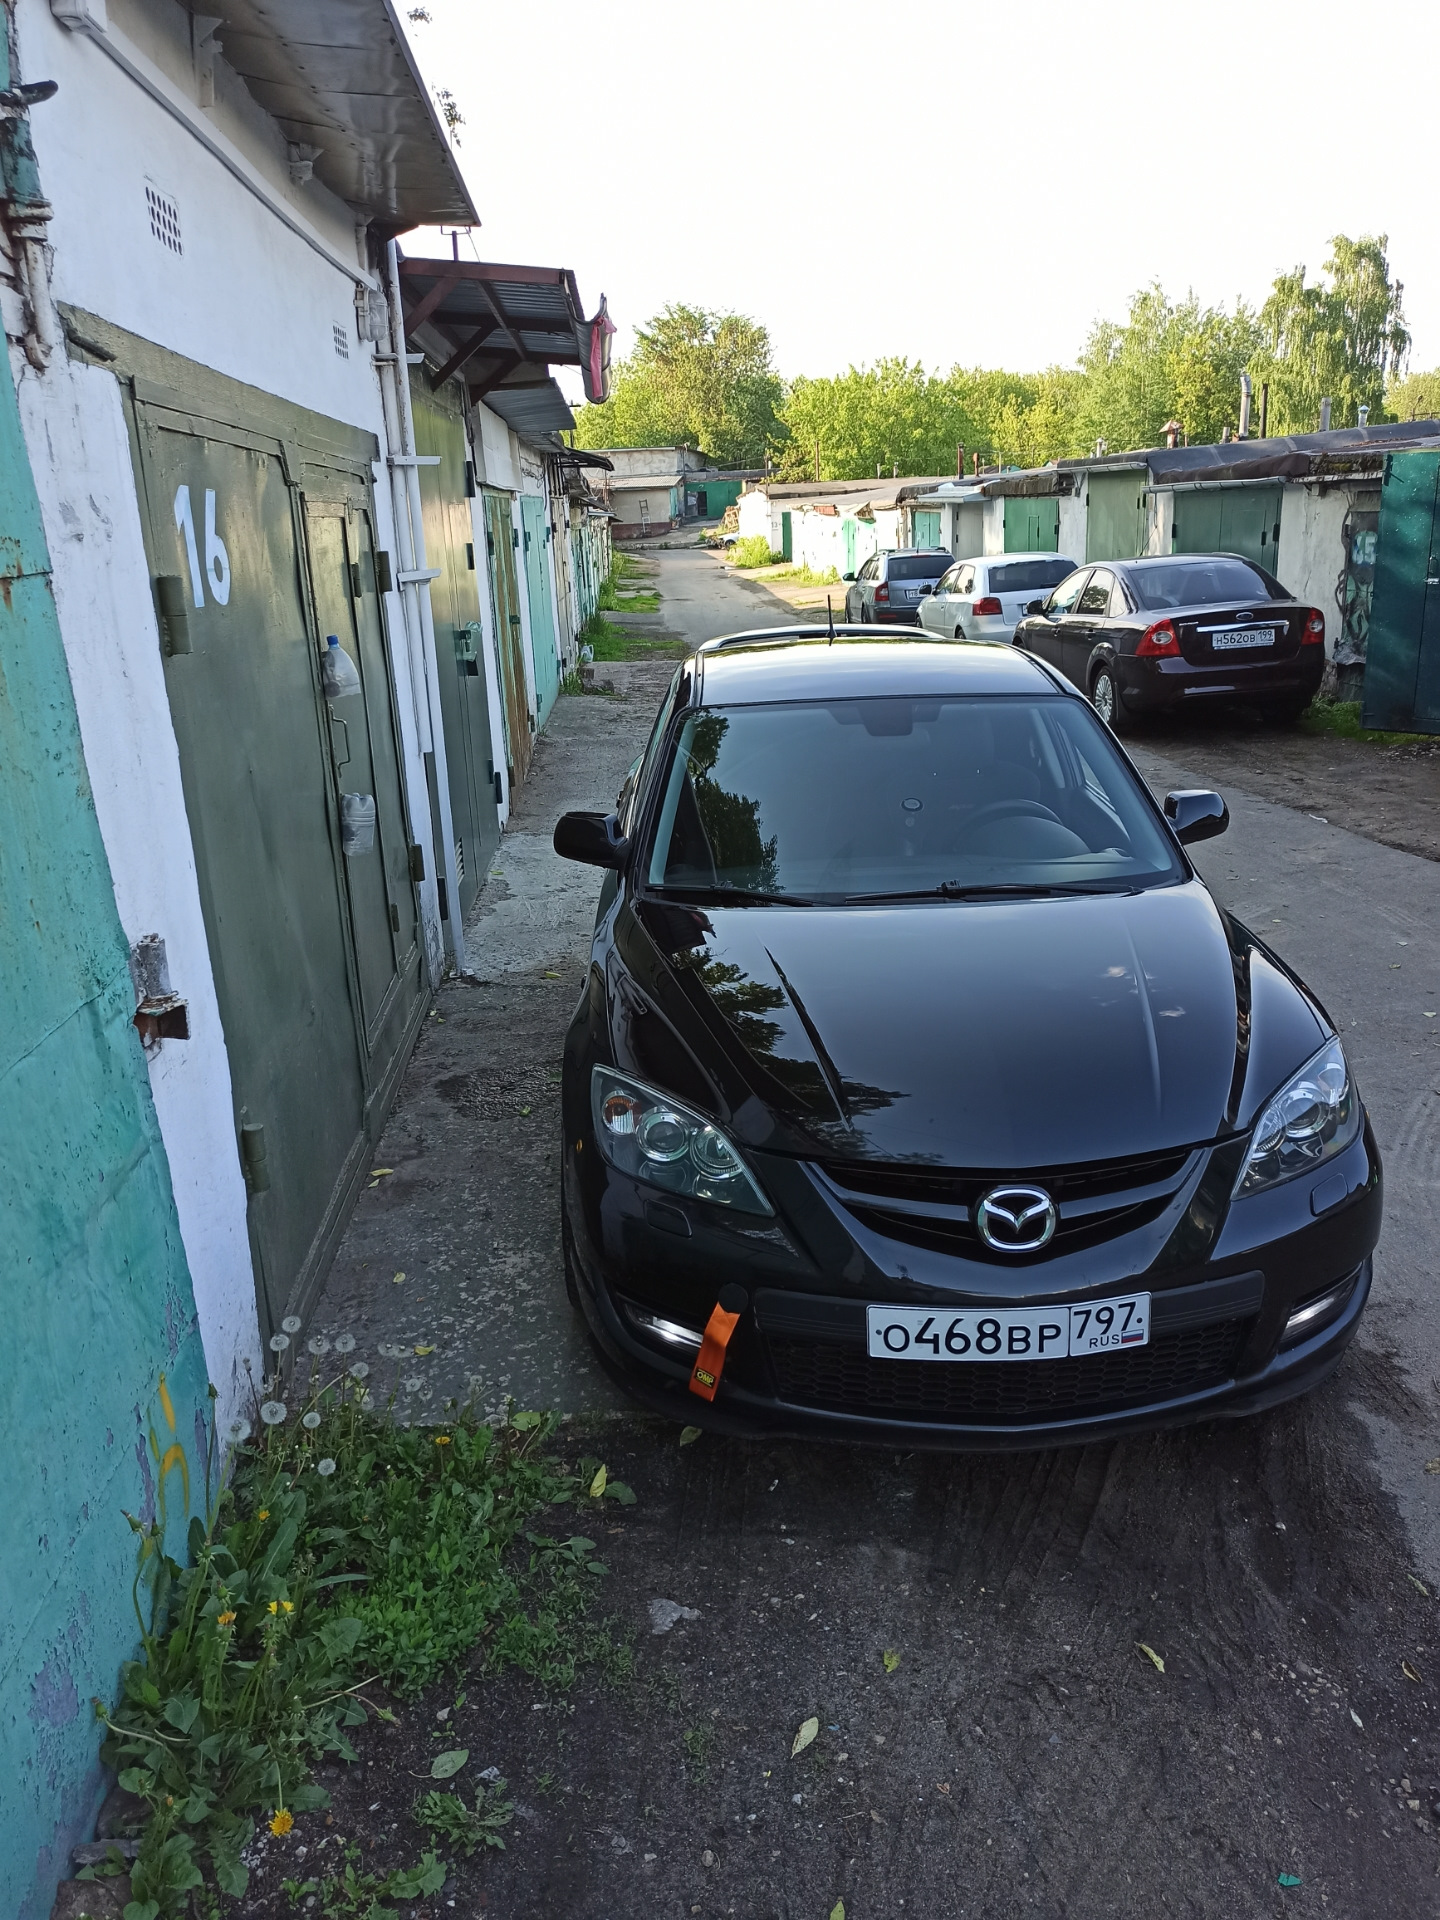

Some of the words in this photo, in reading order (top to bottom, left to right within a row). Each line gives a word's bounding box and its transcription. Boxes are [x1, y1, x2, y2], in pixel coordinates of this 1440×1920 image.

[174, 485, 231, 608] 16
[882, 1317, 1062, 1355] О468ВР
[1073, 1301, 1137, 1339] 797
[1089, 1334, 1120, 1349] RUS
[696, 1371, 714, 1384] OMP
